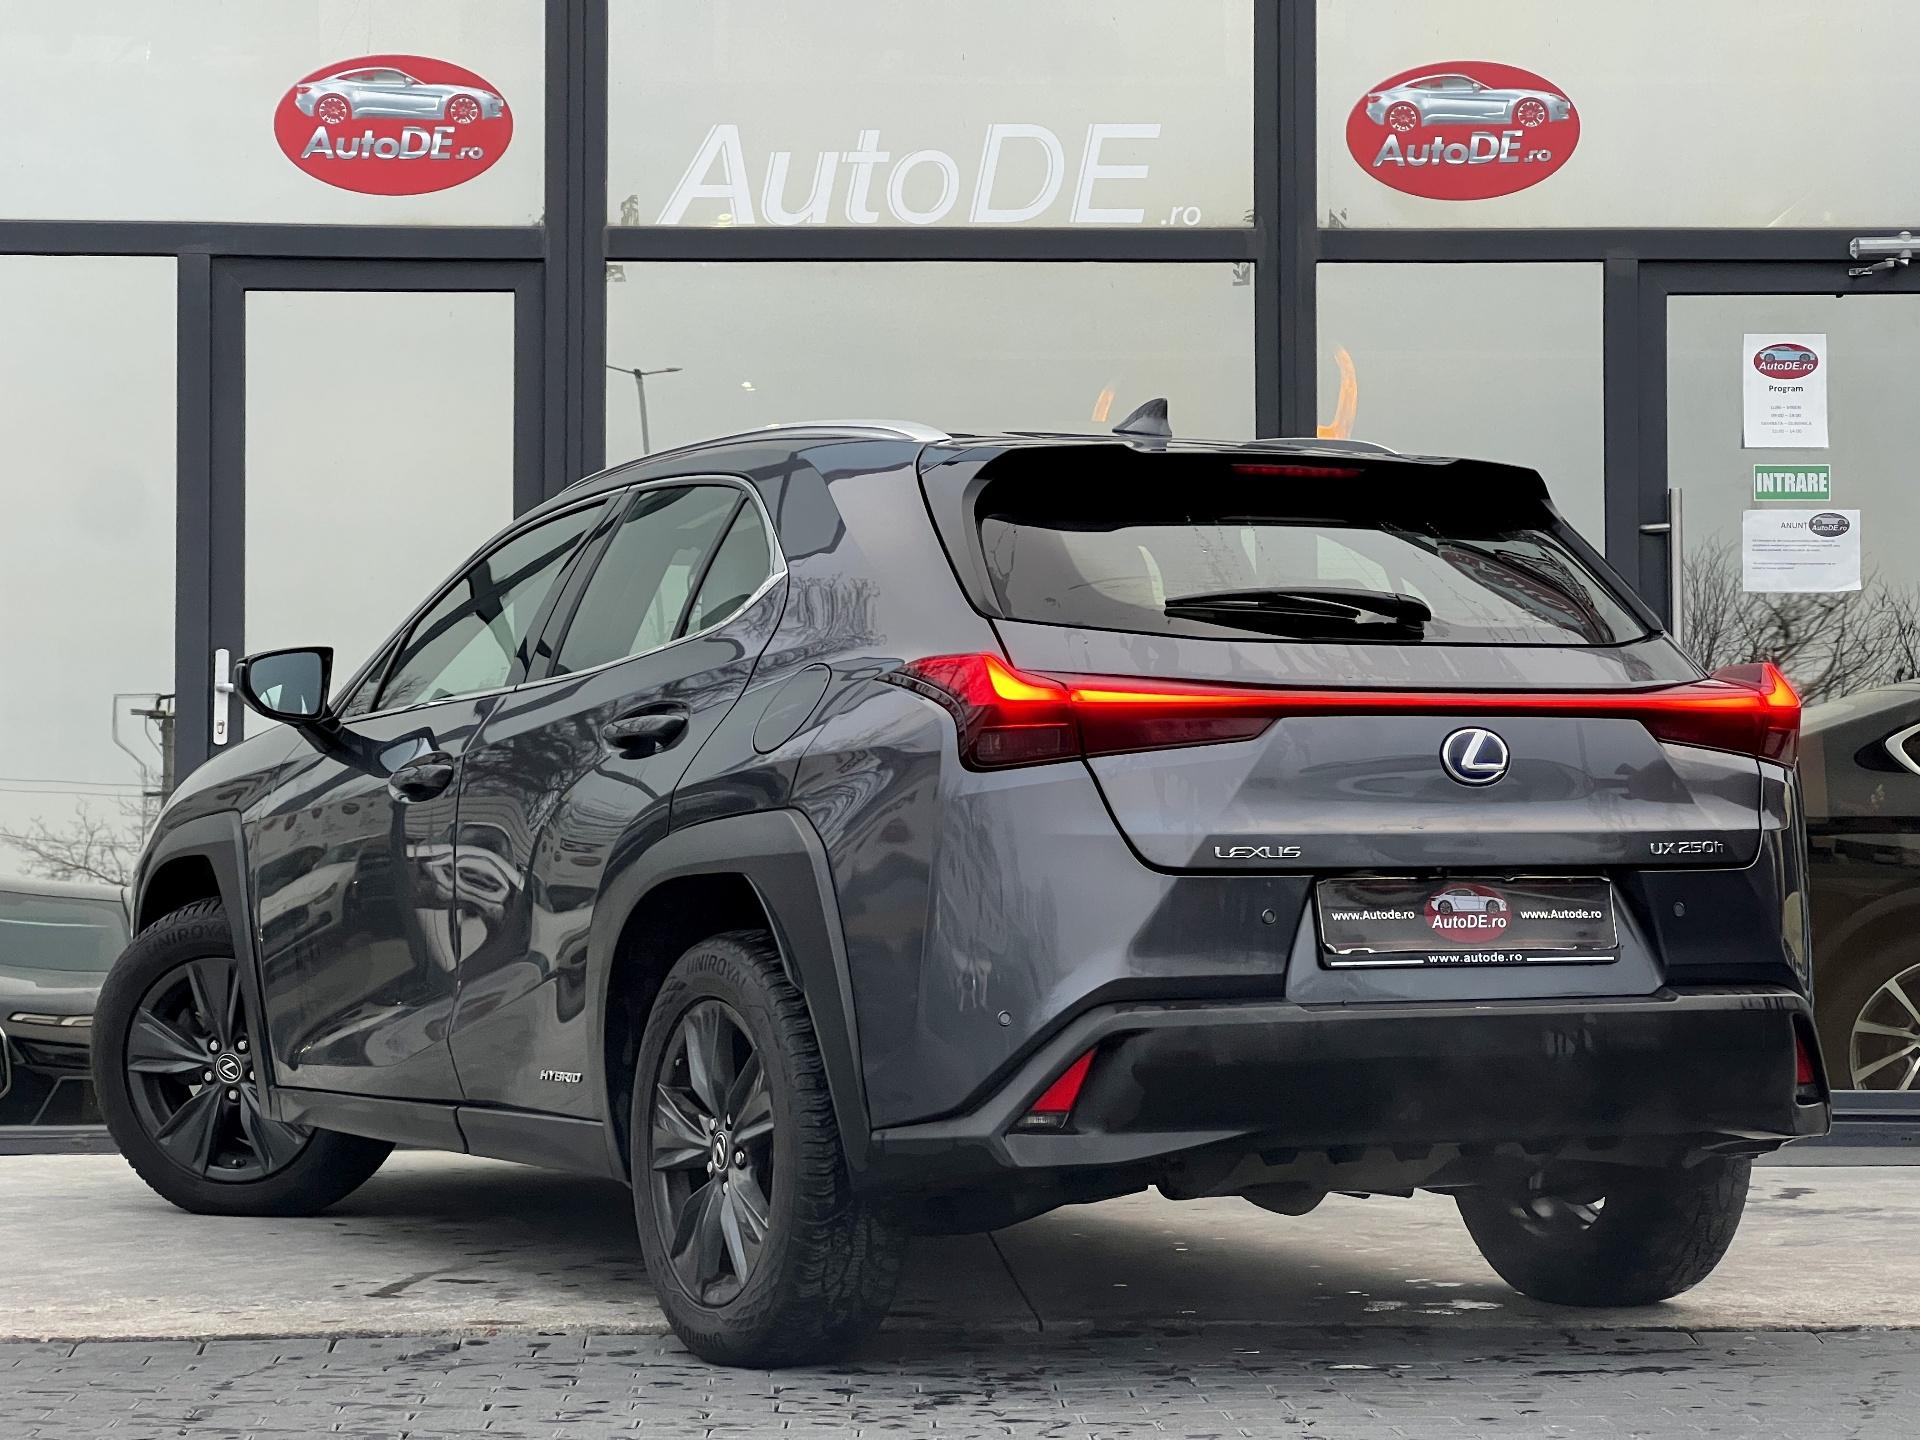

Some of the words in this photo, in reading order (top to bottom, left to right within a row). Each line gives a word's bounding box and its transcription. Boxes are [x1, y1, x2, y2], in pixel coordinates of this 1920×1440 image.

[1758, 361, 1814, 371] AutoDE.ro
[1768, 385, 1804, 394] Program
[1756, 472, 1828, 492] INTRARE
[1811, 524, 1848, 532] AutoDE.ro
[1214, 846, 1302, 858] LEXUS
[1650, 842, 1676, 855] UX
[1678, 841, 1724, 854] 250h
[1331, 909, 1416, 921] www.Autode.ro
[1520, 908, 1602, 920] www.Autode.ro
[1432, 914, 1507, 929] AutoDE.ro
[1427, 952, 1523, 963] www.autode.ro
[540, 1070, 582, 1083] HYBRID
